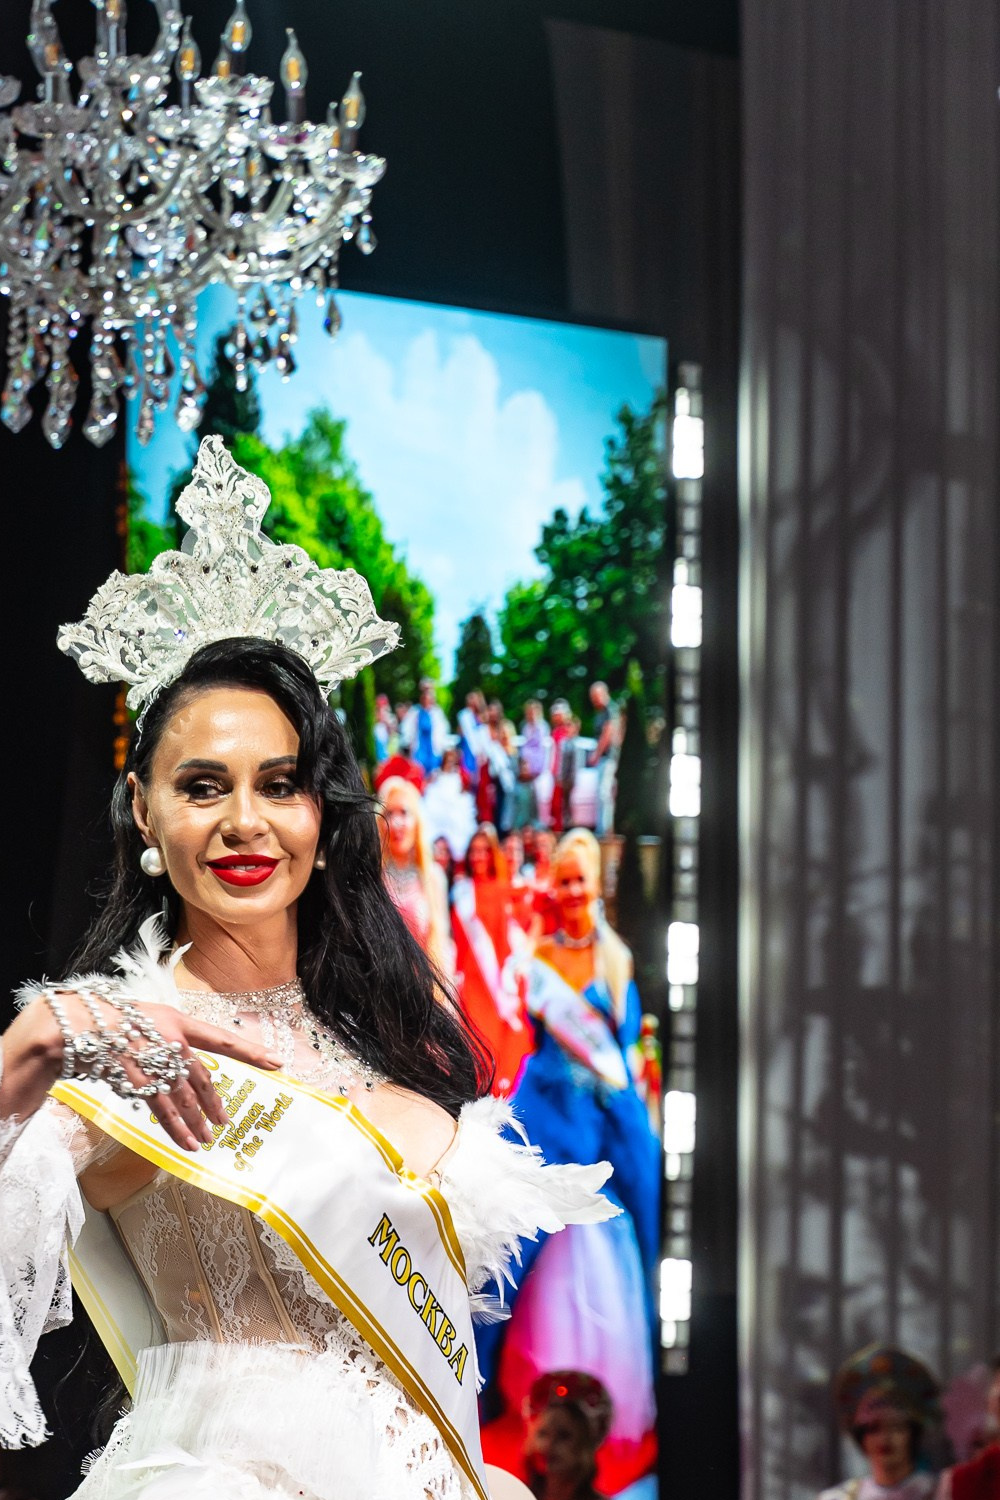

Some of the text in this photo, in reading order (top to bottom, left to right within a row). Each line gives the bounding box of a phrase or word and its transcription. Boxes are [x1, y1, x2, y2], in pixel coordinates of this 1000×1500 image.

[218, 1102, 265, 1150] Women
[233, 1092, 294, 1172] of the World
[367, 1212, 468, 1386] МОСКВА
